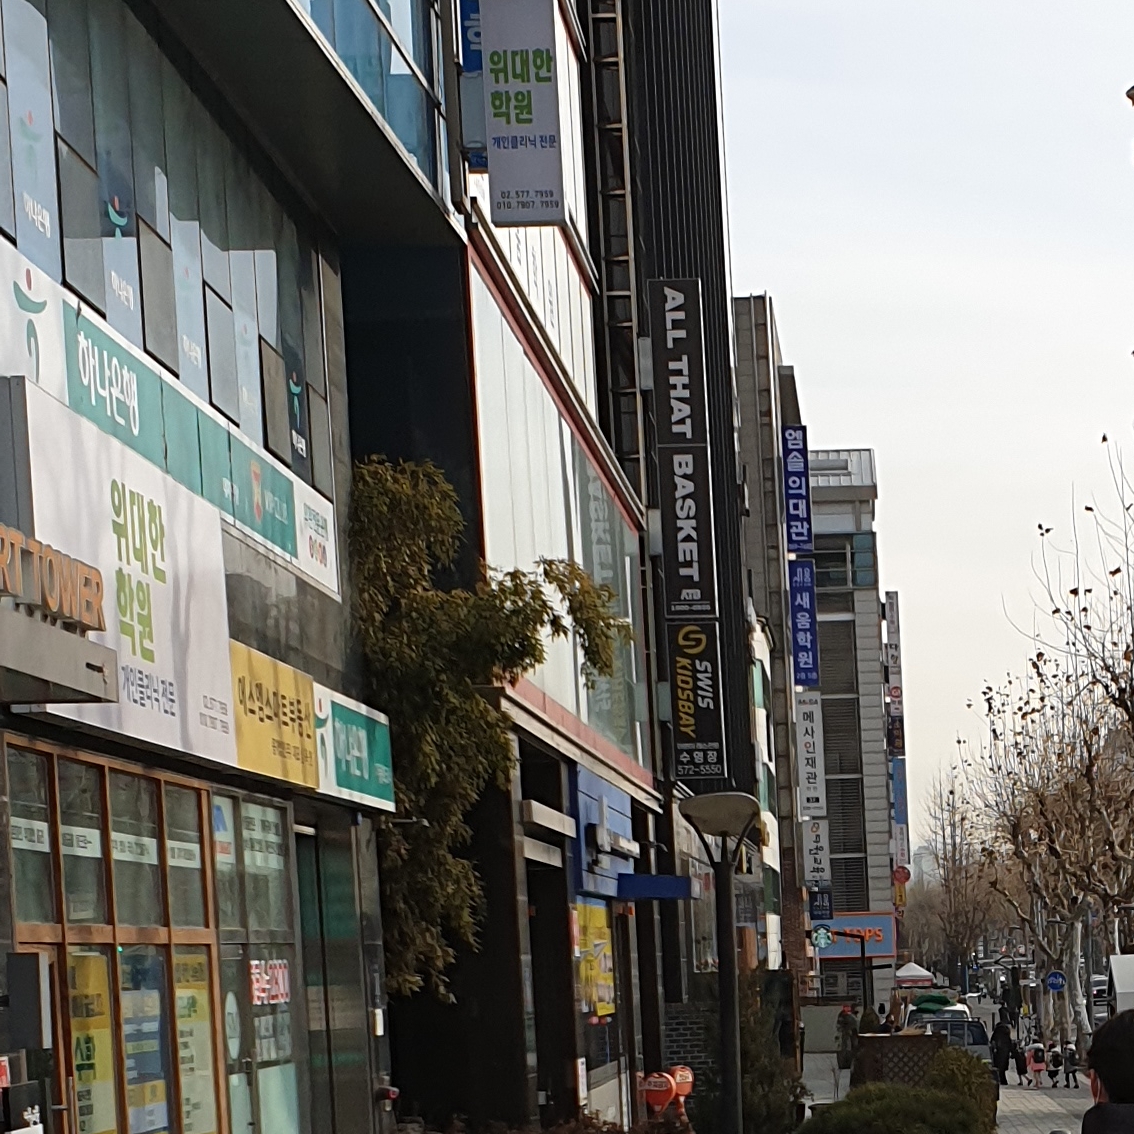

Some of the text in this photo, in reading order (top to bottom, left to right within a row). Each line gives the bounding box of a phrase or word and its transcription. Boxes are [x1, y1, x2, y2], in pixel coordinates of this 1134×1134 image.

[489, 49, 553, 84] 위대한
[490, 90, 533, 125] 학원
[492, 135, 557, 149] 개인클리닉 전문
[663, 286, 687, 349] ALL
[77, 330, 140, 437] 하나은행
[668, 354, 692, 439] THAT
[110, 478, 167, 585] 위대한
[673, 454, 699, 582] BASKET
[24, 537, 107, 632] TOWER
[115, 566, 156, 663] 학원
[121, 665, 162, 711] 개인클리닉
[160, 679, 176, 717] 전문
[675, 656, 696, 739] KIDSBAY
[695, 660, 714, 710] SWIS
[677, 764, 722, 776] 572-5550
[679, 750, 718, 764] 수영장
[802, 710, 818, 785] 메사인재관
